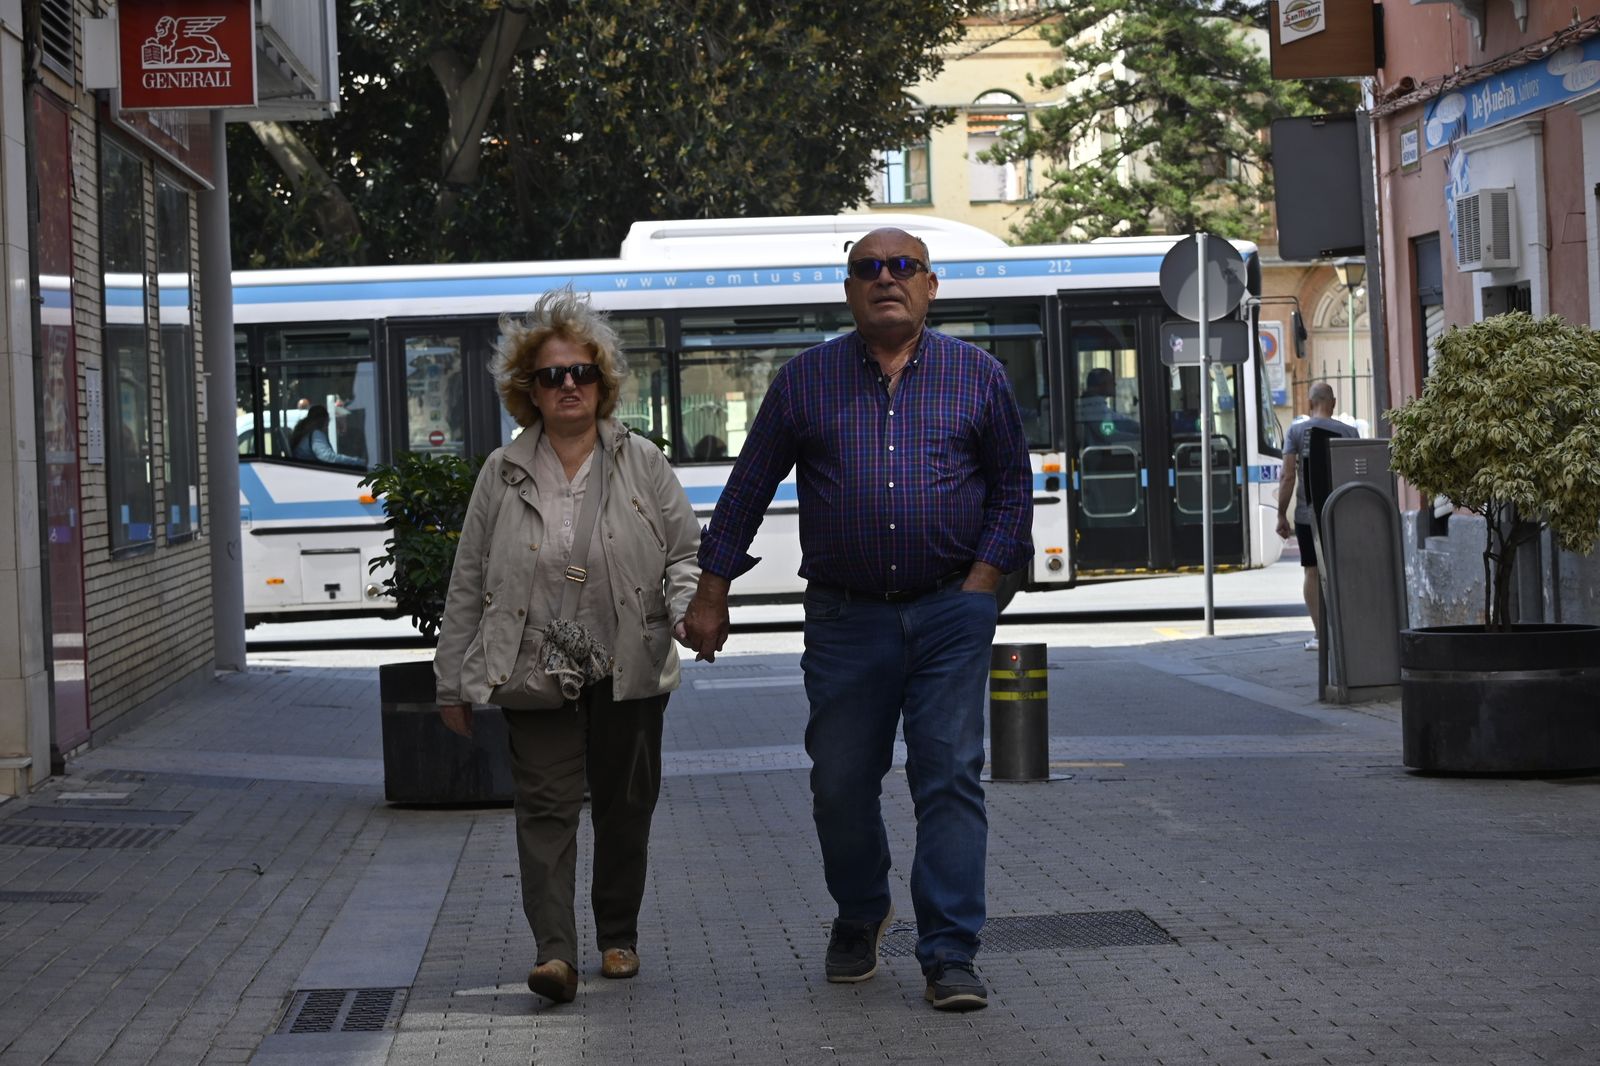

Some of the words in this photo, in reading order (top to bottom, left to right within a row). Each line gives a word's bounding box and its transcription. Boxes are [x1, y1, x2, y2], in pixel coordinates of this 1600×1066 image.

[142, 70, 232, 89] GENERALI
[615, 263, 1006, 289] www.emtusaha.es
[1048, 259, 1072, 274] 212
